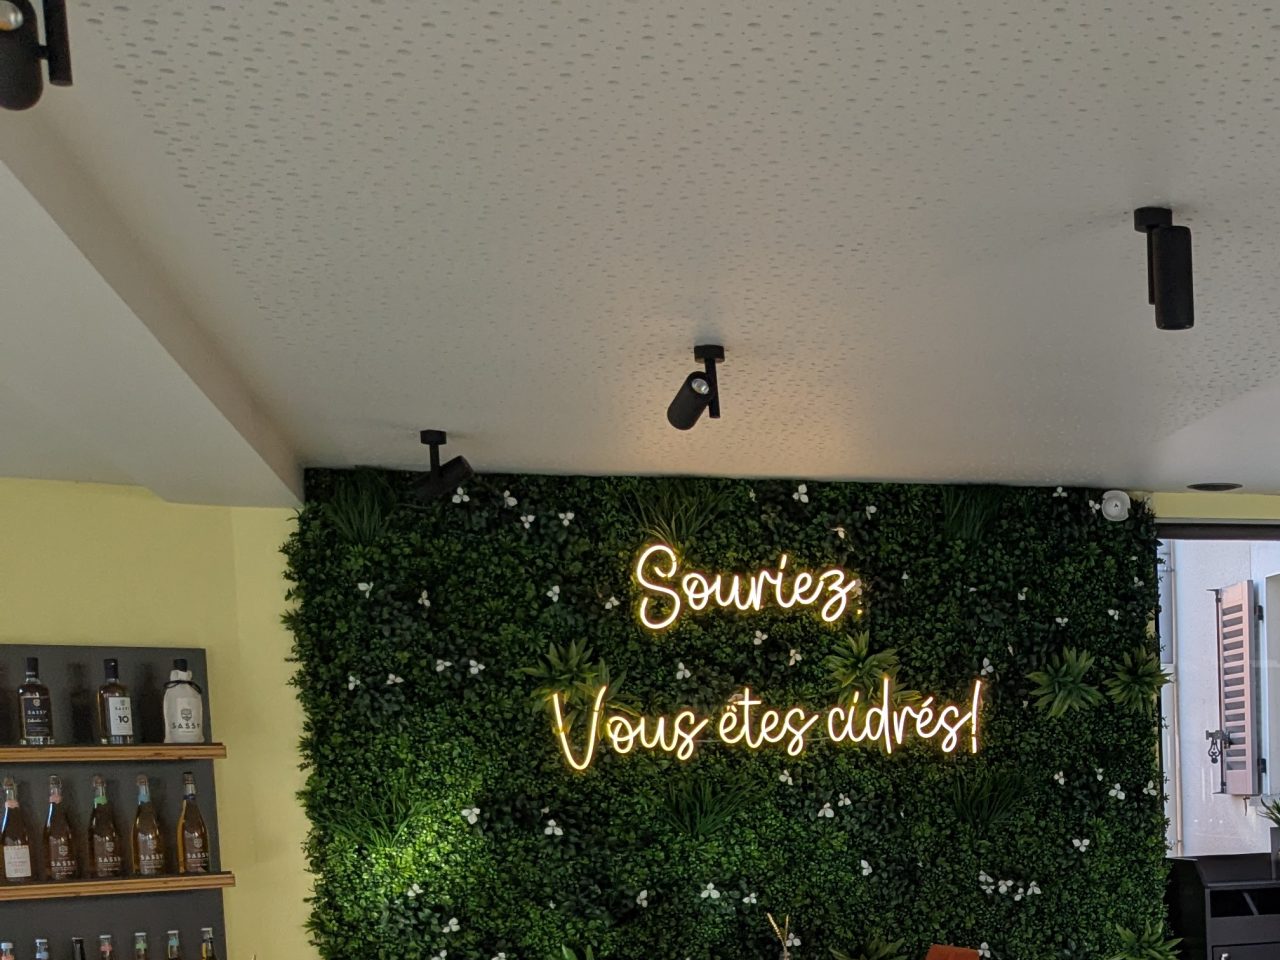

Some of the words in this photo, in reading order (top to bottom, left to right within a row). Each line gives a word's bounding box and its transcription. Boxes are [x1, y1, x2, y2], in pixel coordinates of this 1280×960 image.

[117, 715, 130, 724] 10
[552, 685, 709, 770] Vous
[719, 687, 819, 756] êtes
[827, 677, 982, 755] cidrés!
[172, 722, 200, 730] SASSY
